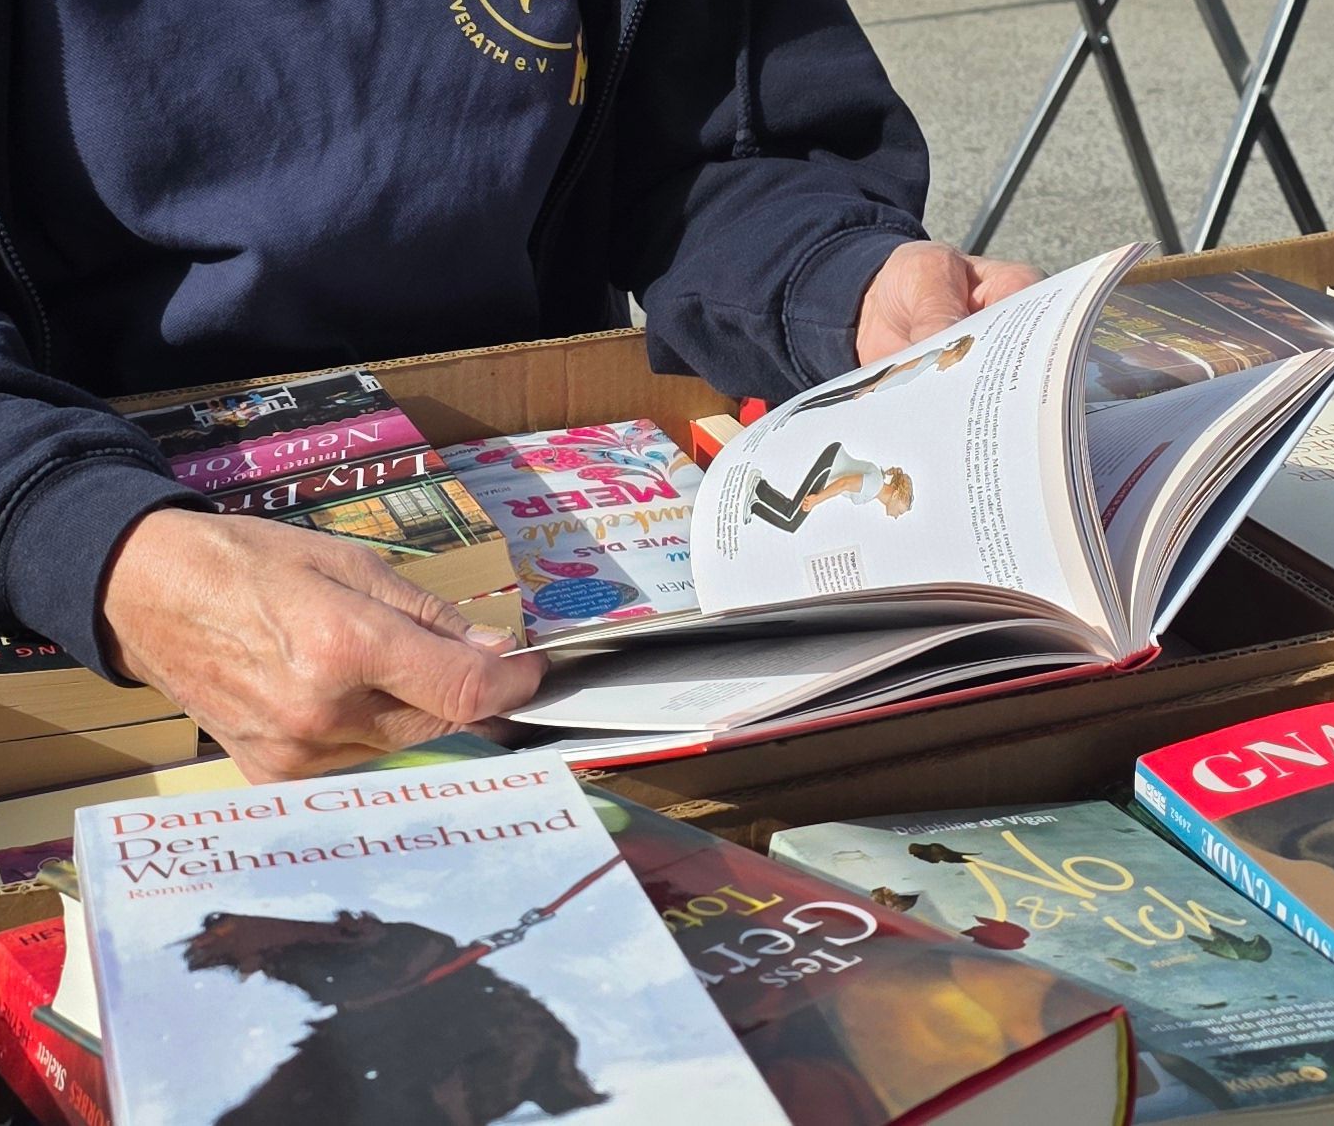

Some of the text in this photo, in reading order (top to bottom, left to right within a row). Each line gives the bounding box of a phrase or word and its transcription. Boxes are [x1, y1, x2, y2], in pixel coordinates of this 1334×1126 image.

[273, 421, 388, 458] New
[314, 451, 430, 492] Lily
[502, 480, 682, 519] MEER
[573, 534, 689, 558] WIE DAS
[108, 768, 551, 837] Daniel Glattauer
[891, 812, 1059, 838] Delphine de Vigan
[113, 830, 221, 861] Der
[117, 809, 581, 884] Weihnachtshund
[1199, 827, 1273, 909] GNADE
[127, 880, 215, 901] Roman
[1080, 885, 1248, 947] ich
[758, 948, 863, 989] Tess
